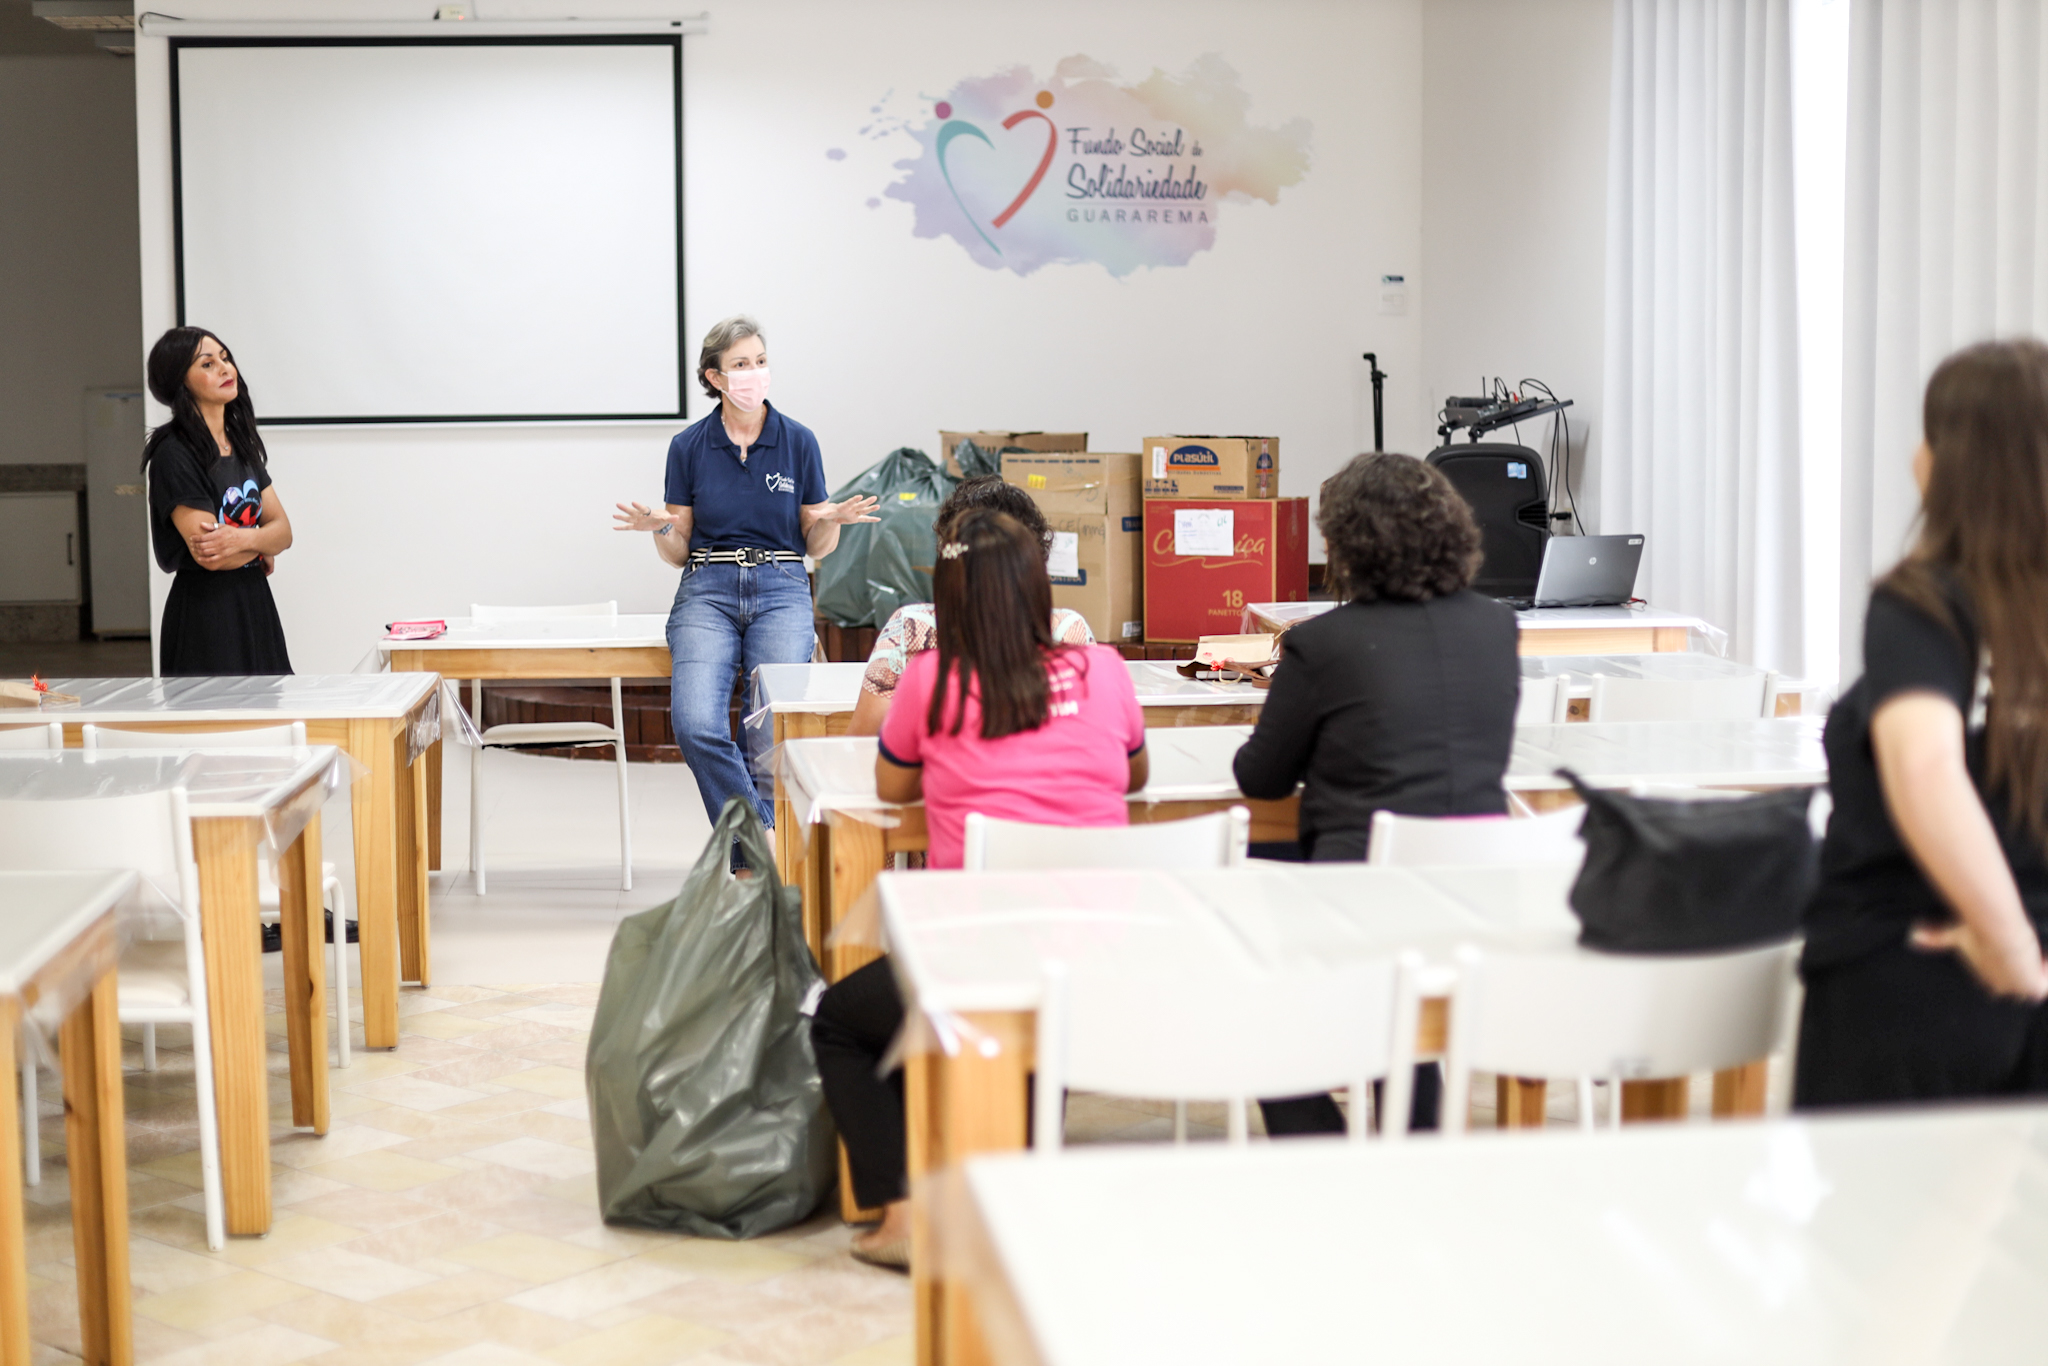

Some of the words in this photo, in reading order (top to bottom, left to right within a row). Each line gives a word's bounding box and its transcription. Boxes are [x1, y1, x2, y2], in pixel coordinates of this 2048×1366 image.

[1066, 127, 1125, 155] Fundo
[1129, 127, 1184, 157] Social
[1066, 163, 1207, 199] Solidariedade
[1067, 209, 1208, 224] GUARAREMA
[1222, 589, 1244, 608] 18
[1208, 608, 1244, 617] PANETTO
